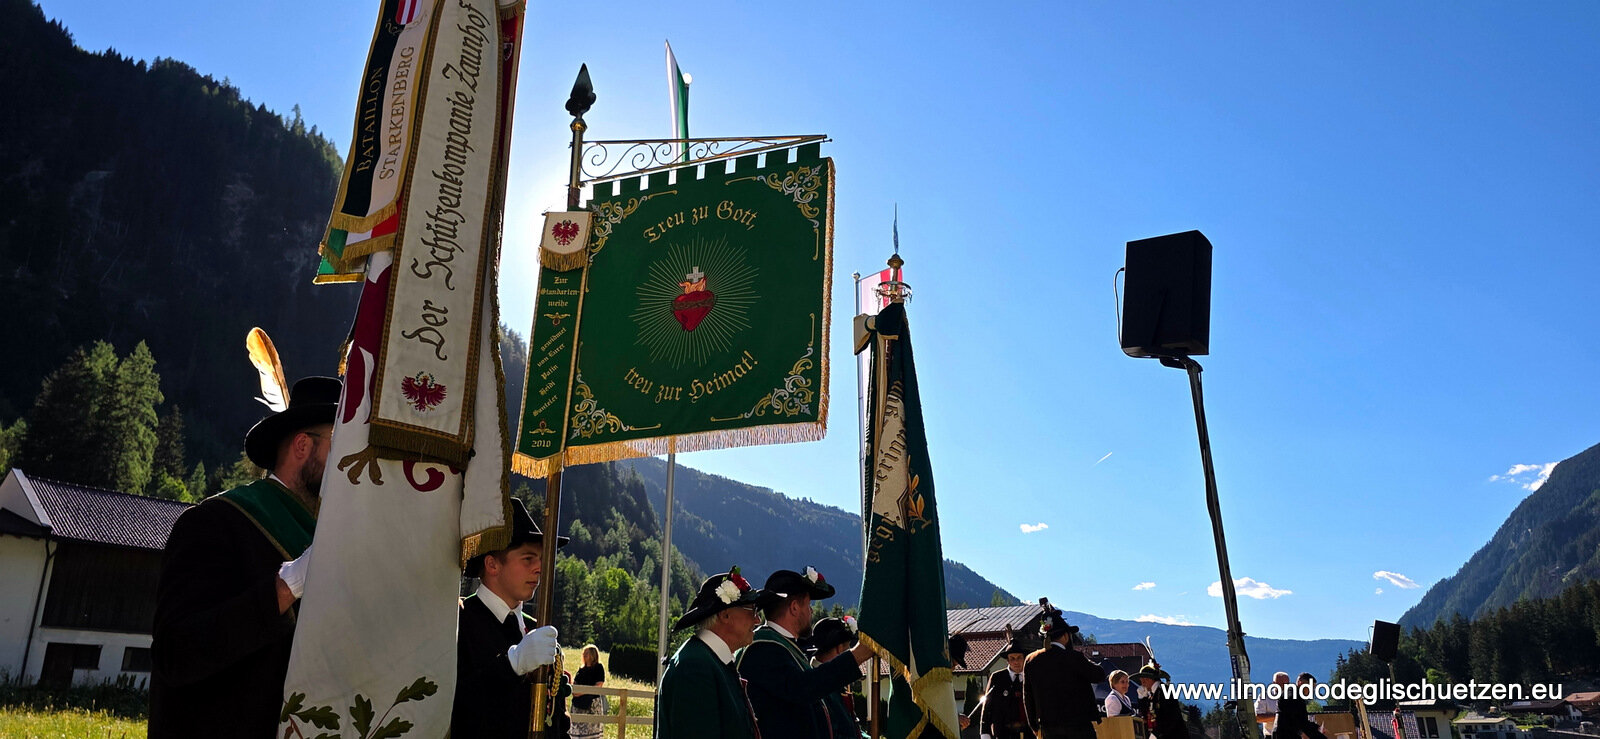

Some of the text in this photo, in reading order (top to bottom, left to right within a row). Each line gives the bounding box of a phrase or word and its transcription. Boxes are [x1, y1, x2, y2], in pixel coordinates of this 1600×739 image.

[356, 66, 384, 173] BATAILLON
[379, 46, 414, 180] STARKENBERG
[402, 0, 490, 361] Der Schützenkompanie Zaunhof
[643, 200, 758, 243] Treu zu Gott,
[553, 276, 568, 284] Zur
[540, 327, 567, 352] gewidmet
[536, 356, 549, 368] von
[541, 364, 559, 380] Patin
[624, 350, 759, 404] treu zur Heimat!
[531, 440, 552, 448] 2010
